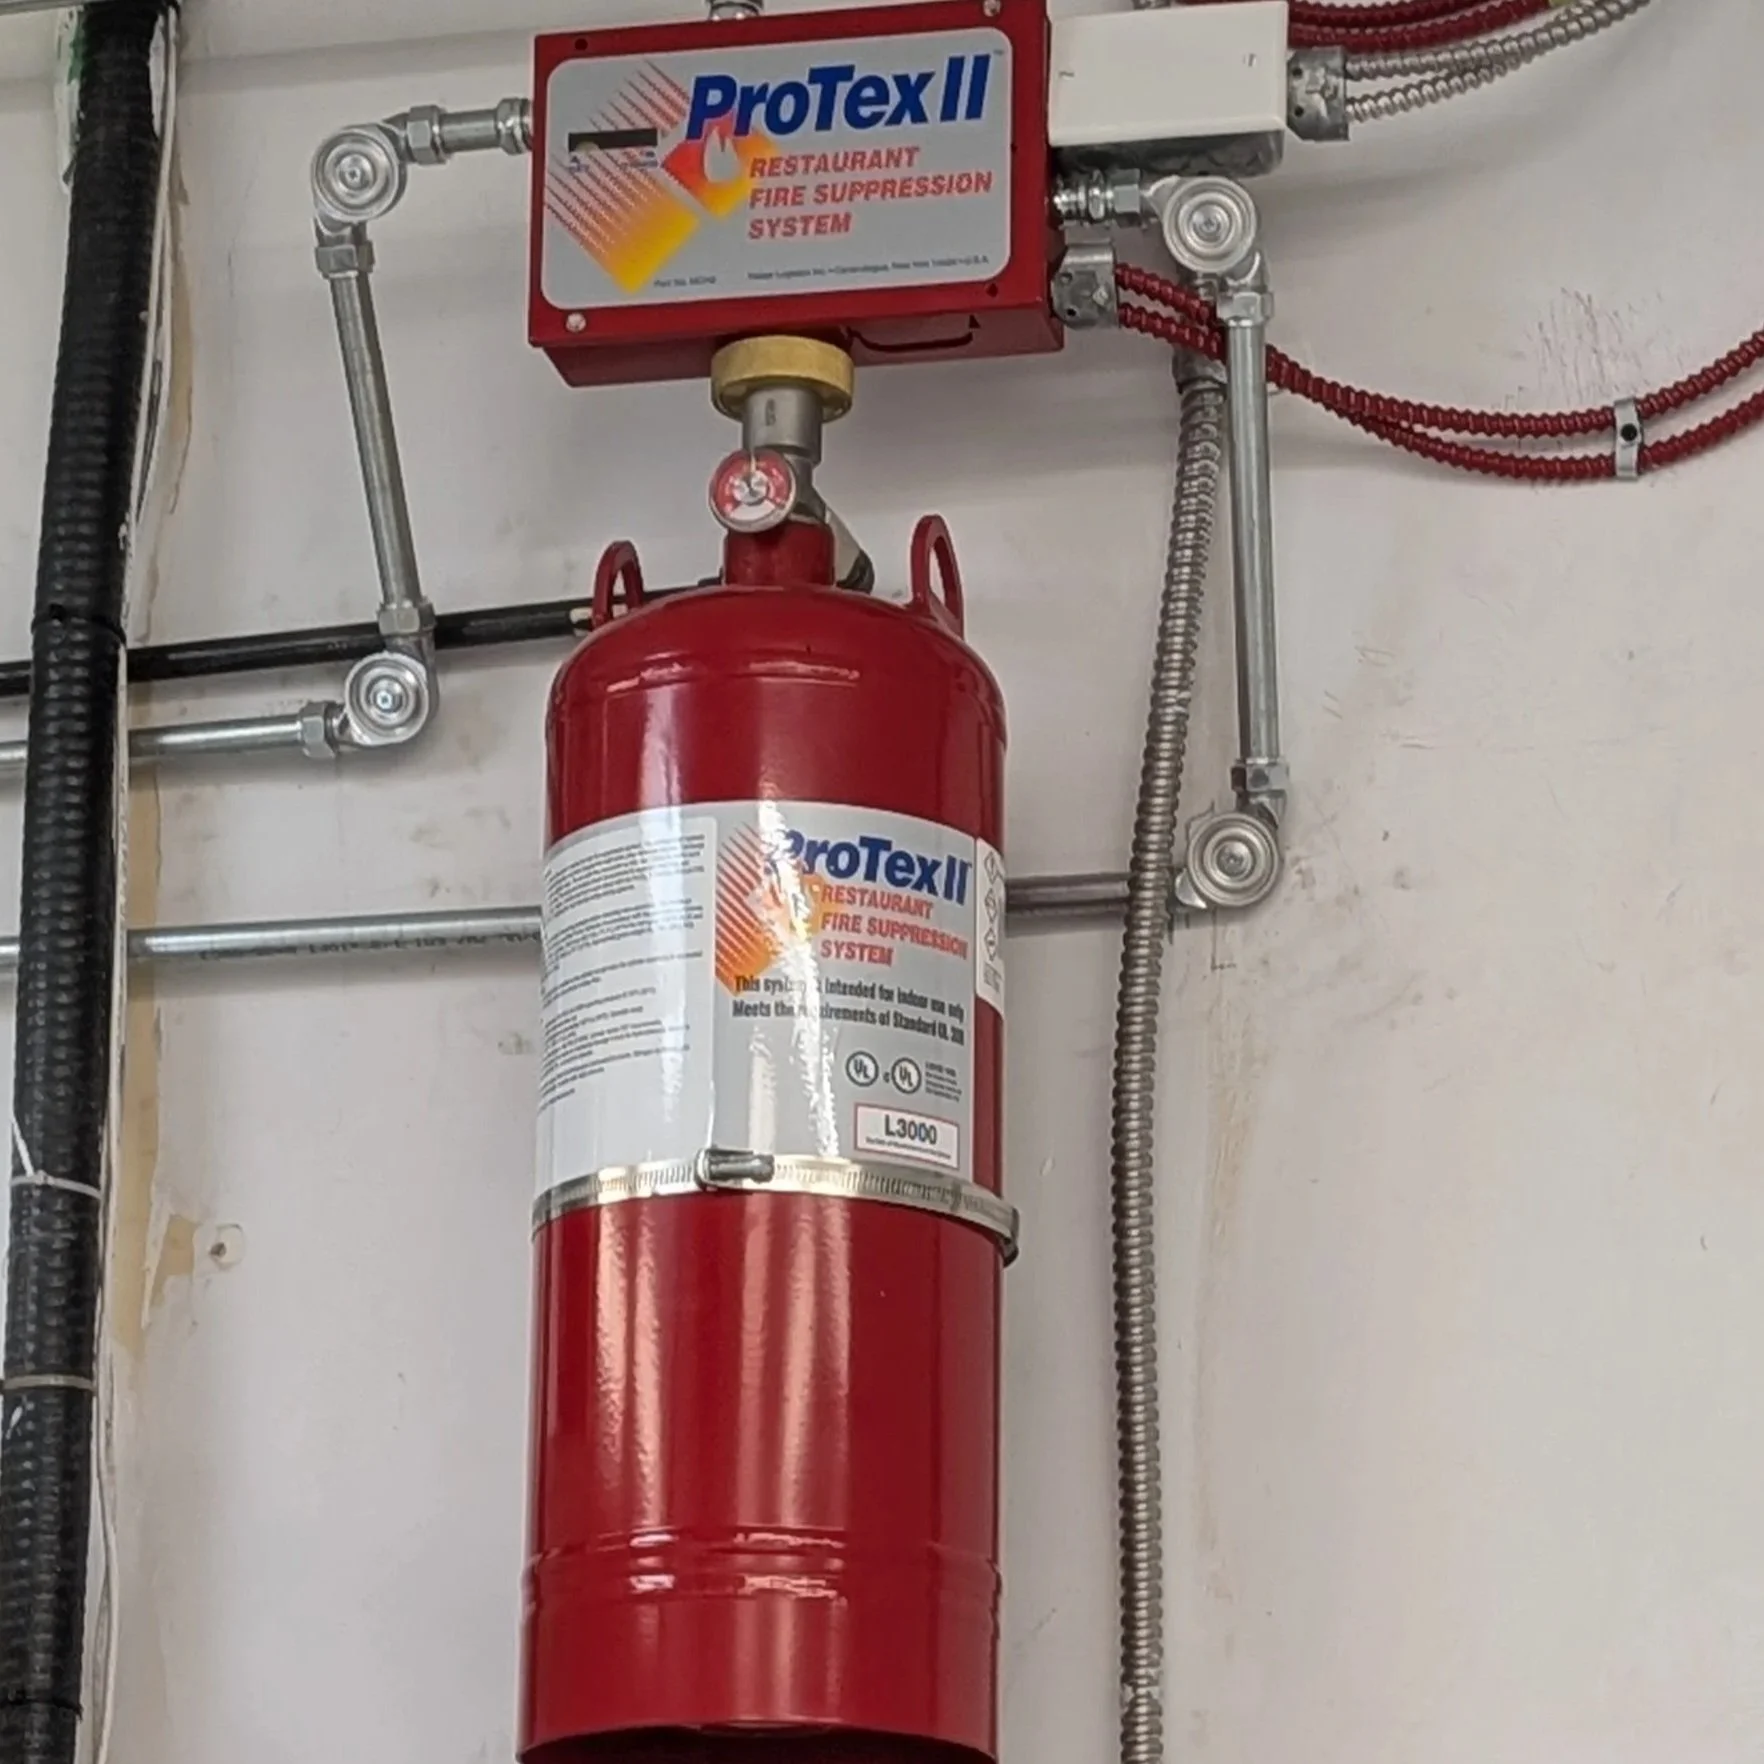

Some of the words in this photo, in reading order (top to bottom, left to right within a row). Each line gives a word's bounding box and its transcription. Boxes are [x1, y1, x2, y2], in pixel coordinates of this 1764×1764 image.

[686, 64, 935, 140] ProTex
[939, 54, 991, 123] II
[750, 147, 920, 178] RESTAURANT
[749, 186, 807, 209] FIRE
[813, 171, 993, 205] SUPPRESSION
[748, 212, 852, 240] SYSTEM
[943, 854, 969, 906] II
[821, 884, 934, 919] RESTAURANT
[820, 940, 894, 966] SYSTEM
[821, 912, 861, 931] FIRE
[867, 917, 968, 960] SUPPRESSION
[735, 975, 760, 992] This
[824, 977, 876, 999] intended
[878, 984, 894, 1003] for
[732, 1000, 771, 1017] Meets
[774, 1000, 794, 1017] the
[878, 1010, 890, 1026] of
[893, 1009, 937, 1037] Standard
[884, 1114, 938, 1145] L3000
